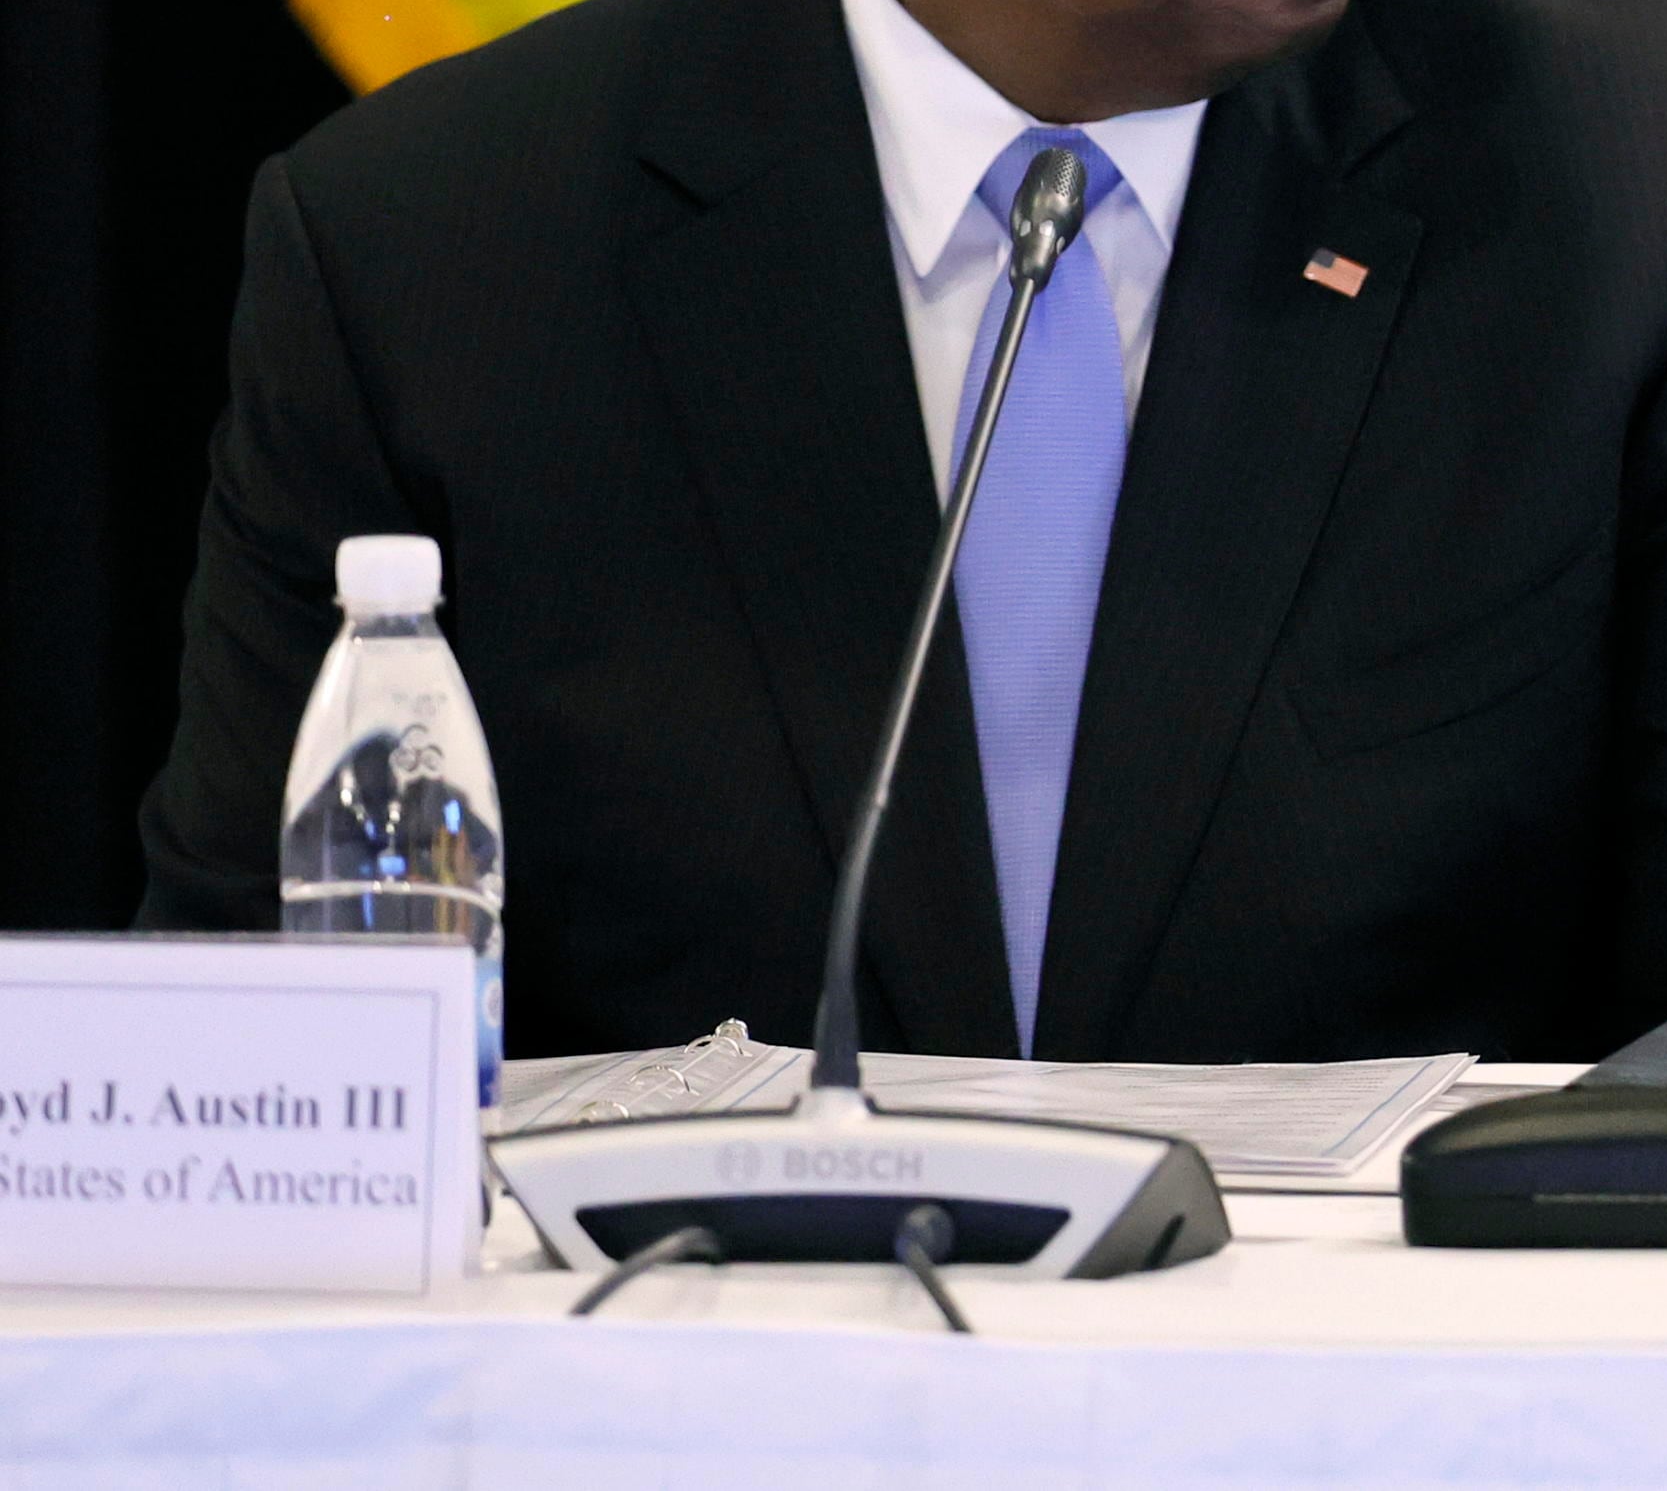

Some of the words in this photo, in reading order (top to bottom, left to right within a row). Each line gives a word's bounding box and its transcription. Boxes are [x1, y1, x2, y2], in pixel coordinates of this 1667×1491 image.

[0, 1079, 71, 1136] yd
[90, 1079, 133, 1127] J.
[149, 1083, 319, 1129] Austin
[344, 1084, 407, 1129] III
[143, 1153, 201, 1201] of
[207, 1157, 417, 1206] America
[781, 1146, 923, 1182] BOSCH
